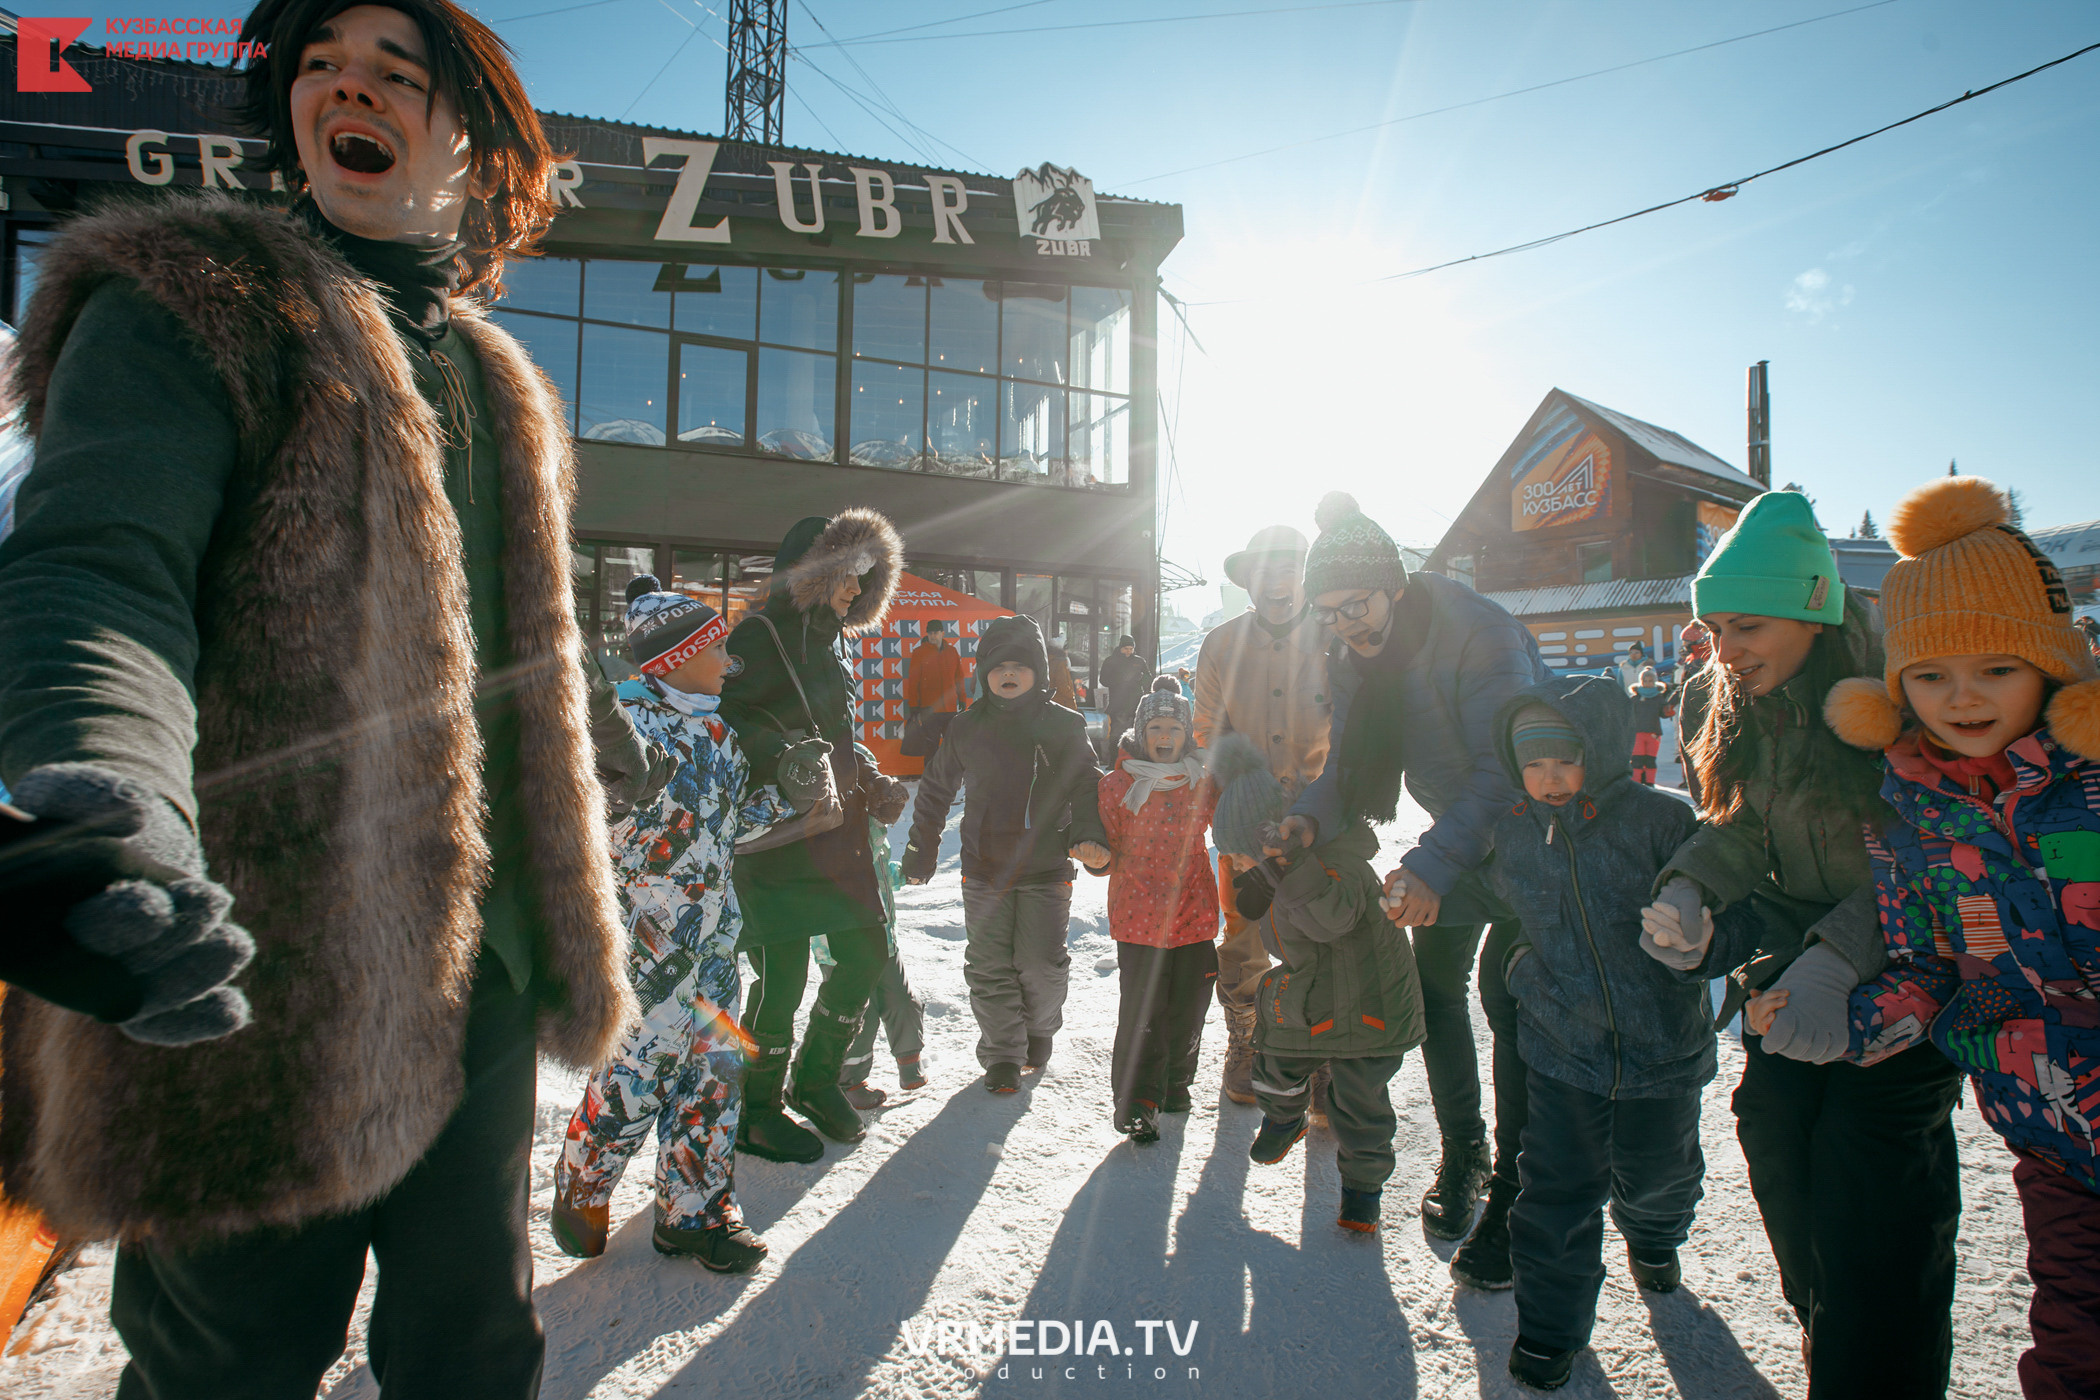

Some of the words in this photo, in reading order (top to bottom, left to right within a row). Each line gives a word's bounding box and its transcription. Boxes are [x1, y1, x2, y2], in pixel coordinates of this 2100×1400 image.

[124, 131, 288, 193] GR
[548, 160, 586, 209] R
[642, 137, 976, 244] ZUBR
[1036, 239, 1091, 256] ZUBR
[1522, 481, 1554, 500] 300
[1522, 490, 1597, 517] КУЗБАСС
[890, 599, 958, 607] ГРУППА
[895, 590, 942, 598] СКАЯ
